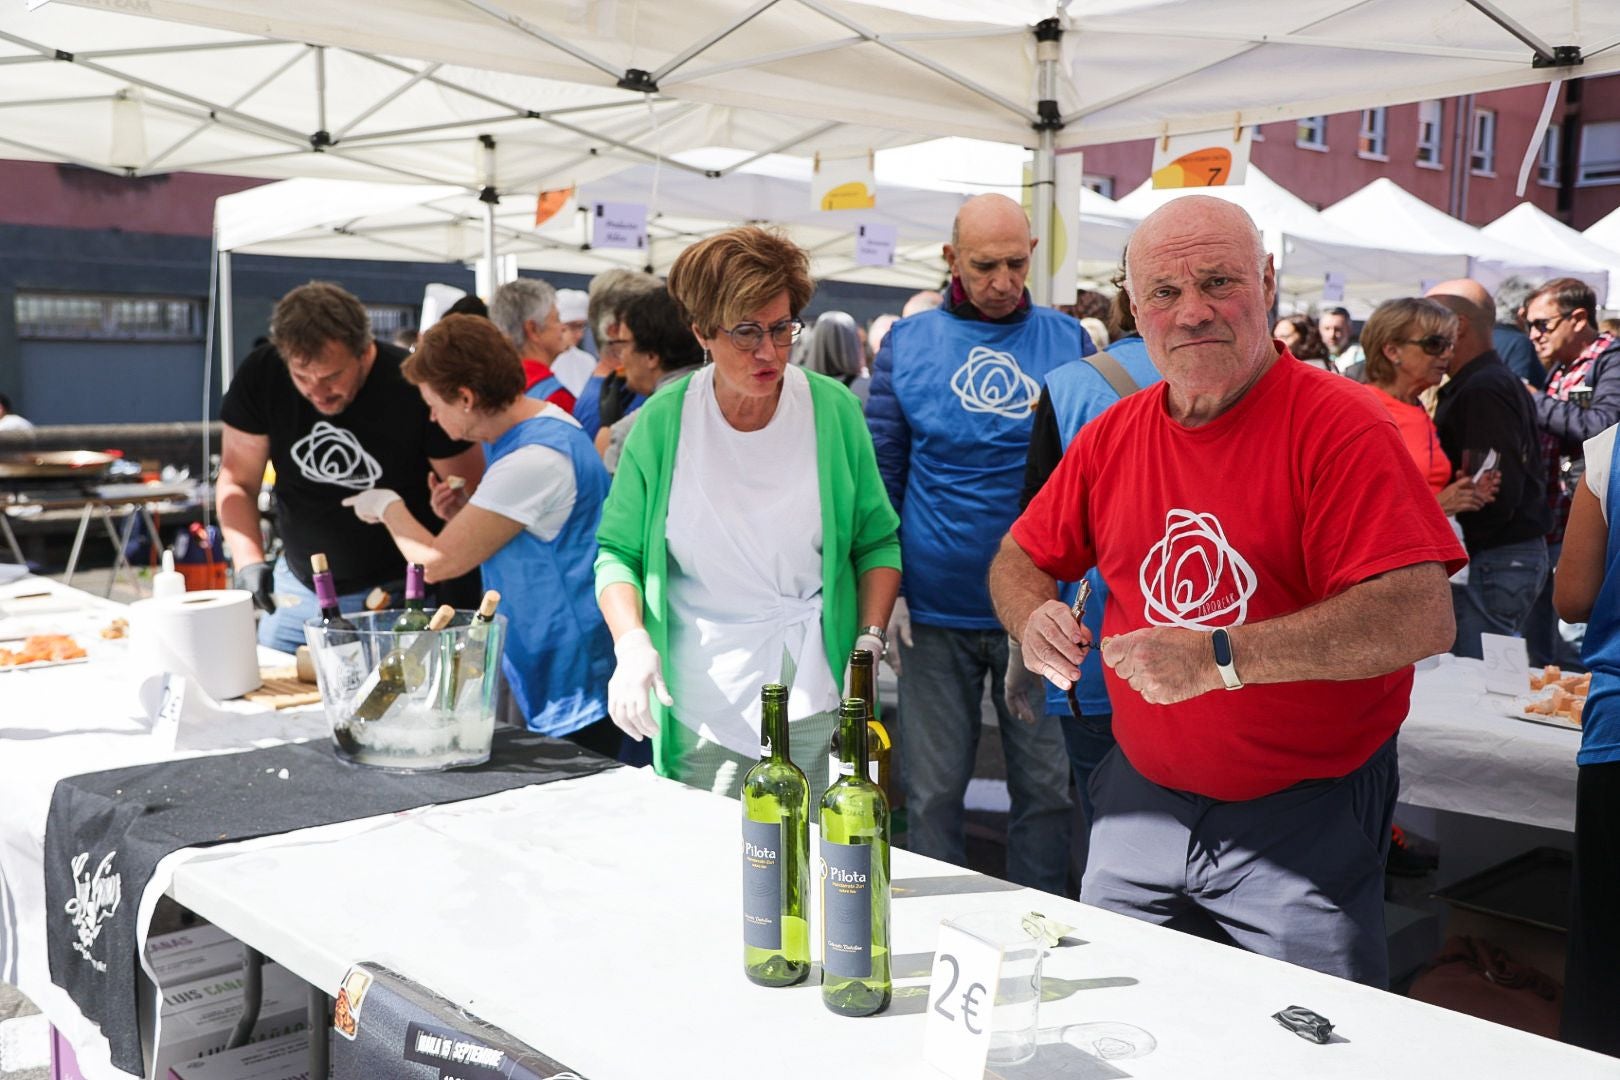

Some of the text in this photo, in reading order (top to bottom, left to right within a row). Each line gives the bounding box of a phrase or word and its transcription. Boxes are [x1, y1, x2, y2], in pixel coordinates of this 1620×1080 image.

[1207, 166, 1223, 187] 7
[745, 842, 776, 859] Pilota
[830, 866, 866, 883] Pilota
[163, 988, 203, 1007] LUIS
[934, 953, 986, 1034] 2€
